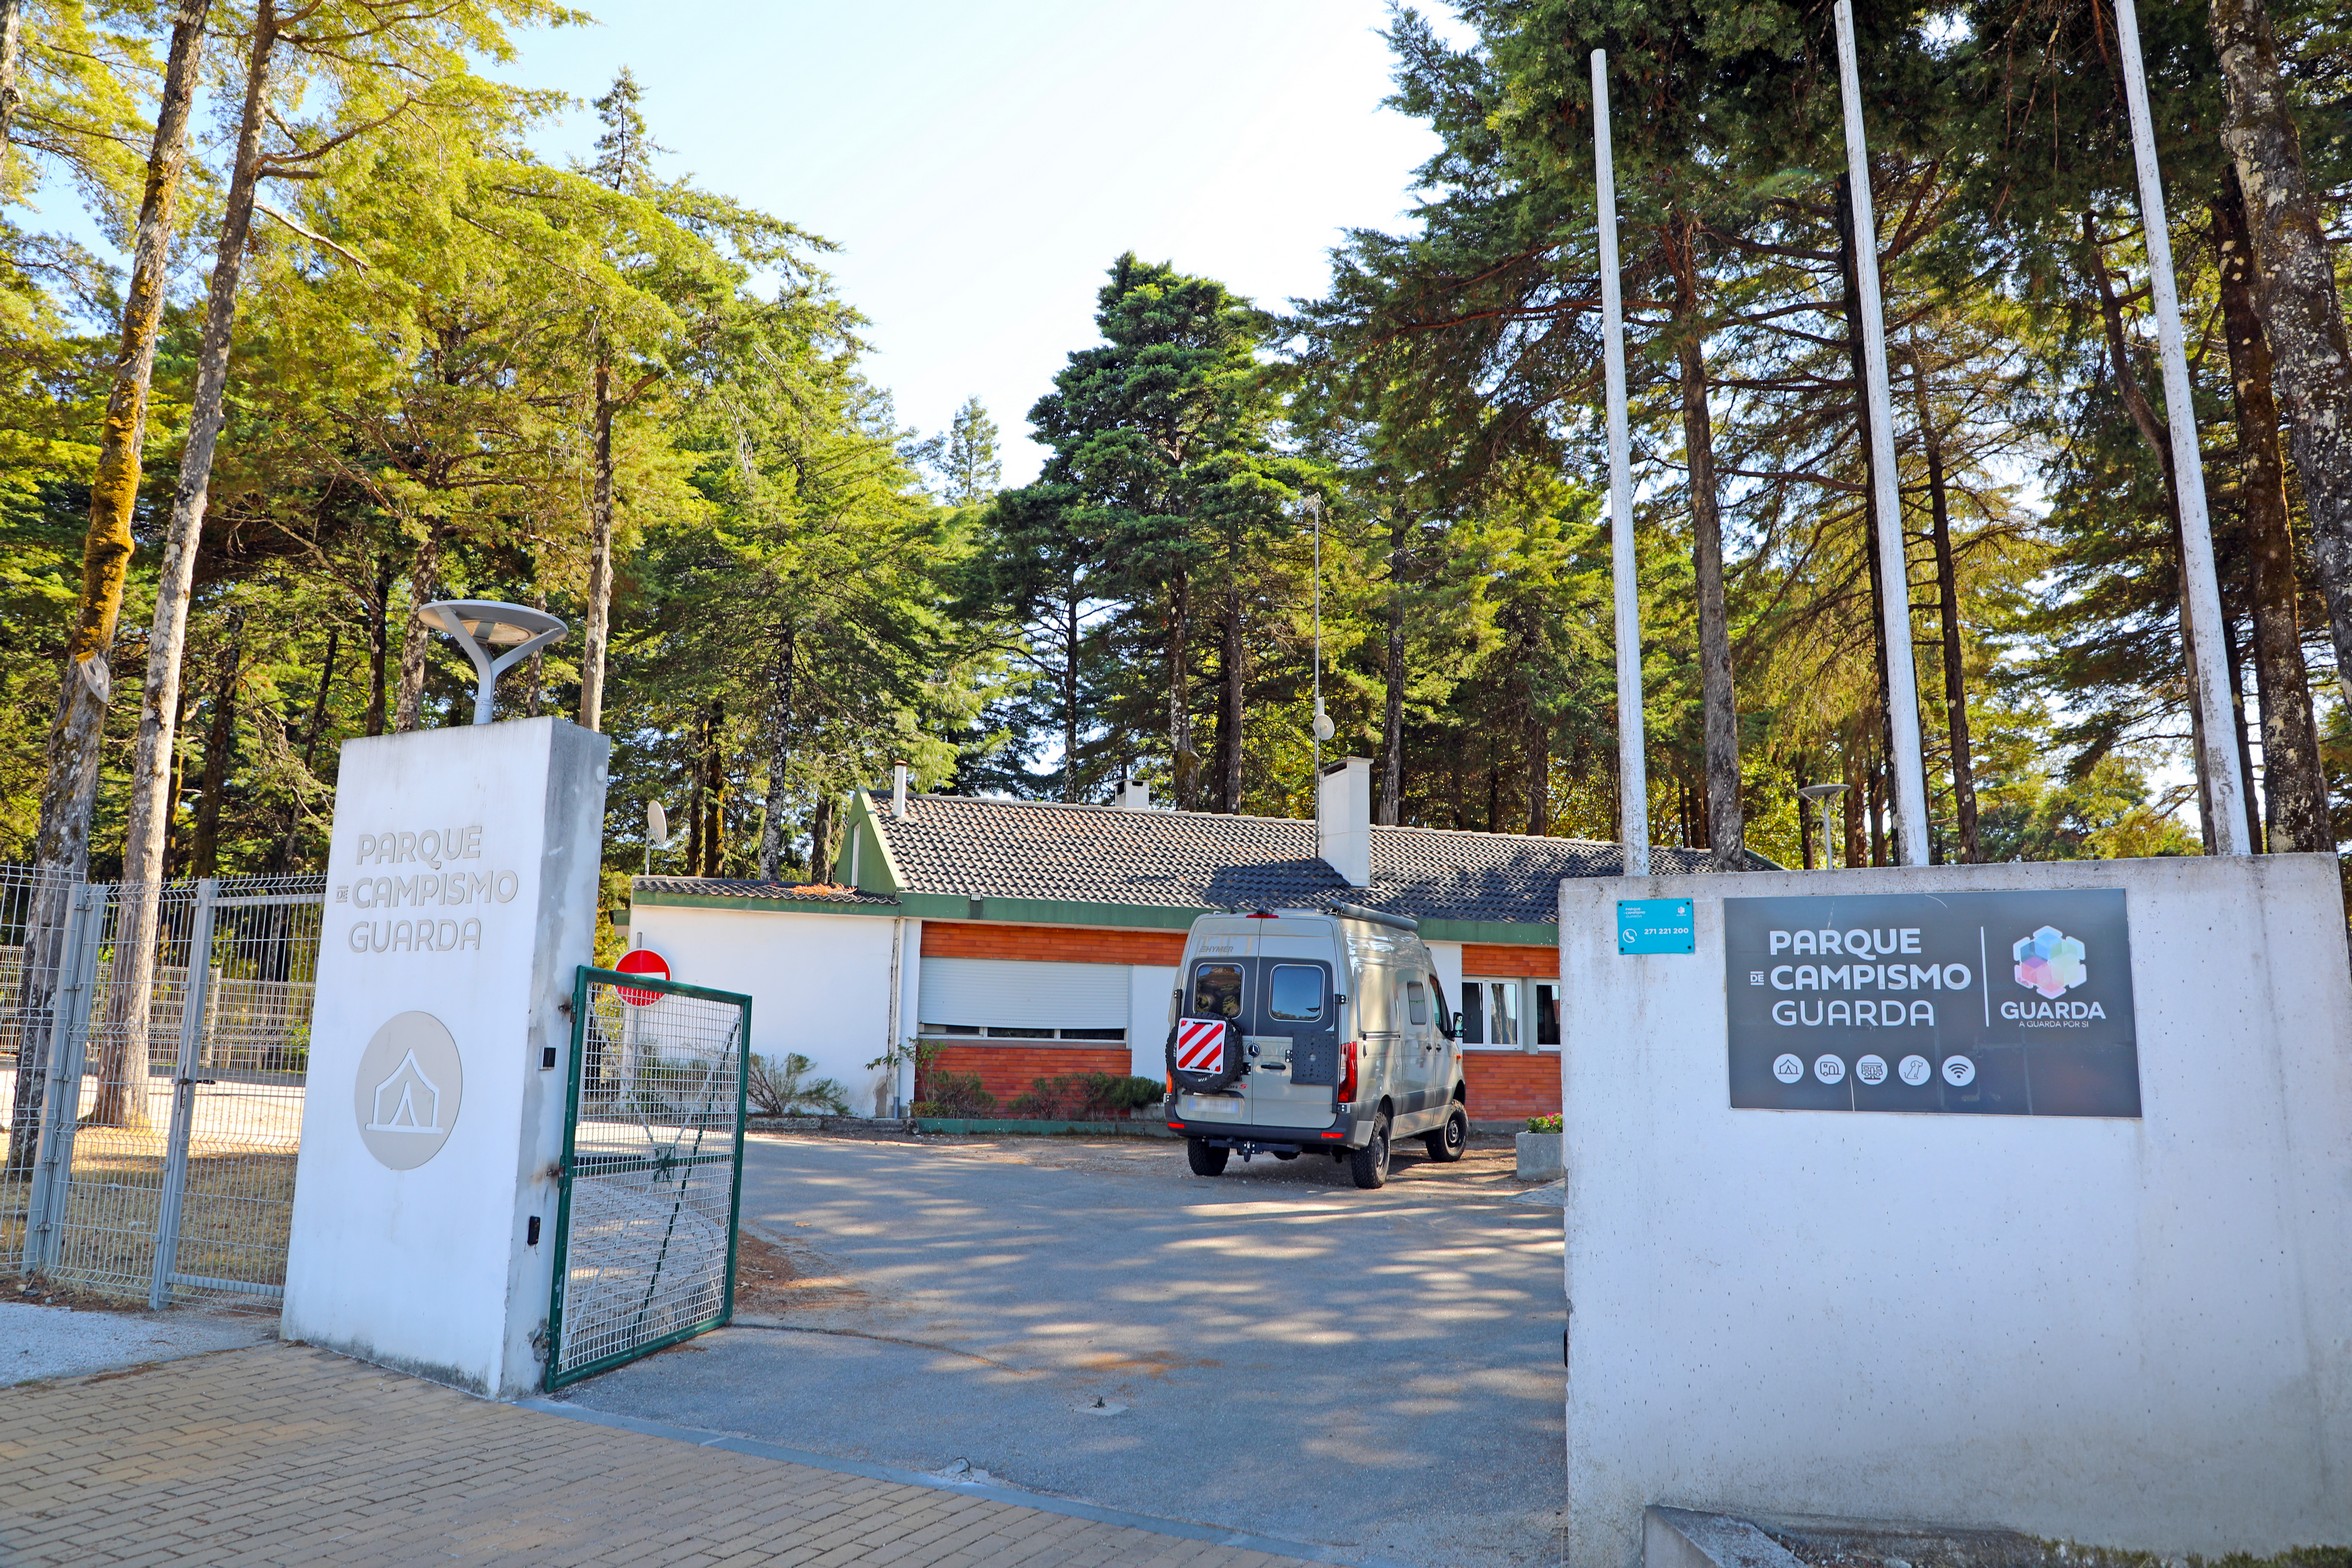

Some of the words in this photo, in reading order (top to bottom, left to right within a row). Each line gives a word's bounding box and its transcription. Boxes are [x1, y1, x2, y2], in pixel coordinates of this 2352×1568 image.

[356, 825, 482, 870] PARQUE
[336, 888, 349, 900] DE
[352, 869, 519, 909] CAMPISMO
[348, 917, 482, 953] GUARDA
[1769, 928, 1922, 961] PARQUE
[1750, 974, 1765, 983] DE
[1770, 963, 1972, 991] CAMPISMO
[1771, 1000, 1935, 1027] GUARDA
[2000, 1001, 2106, 1020] GUARDA
[2019, 1020, 2025, 1028] A
[2026, 1020, 2061, 1028] GUARDA
[2063, 1020, 2080, 1028] POR
[2081, 1020, 2089, 1028] SI
